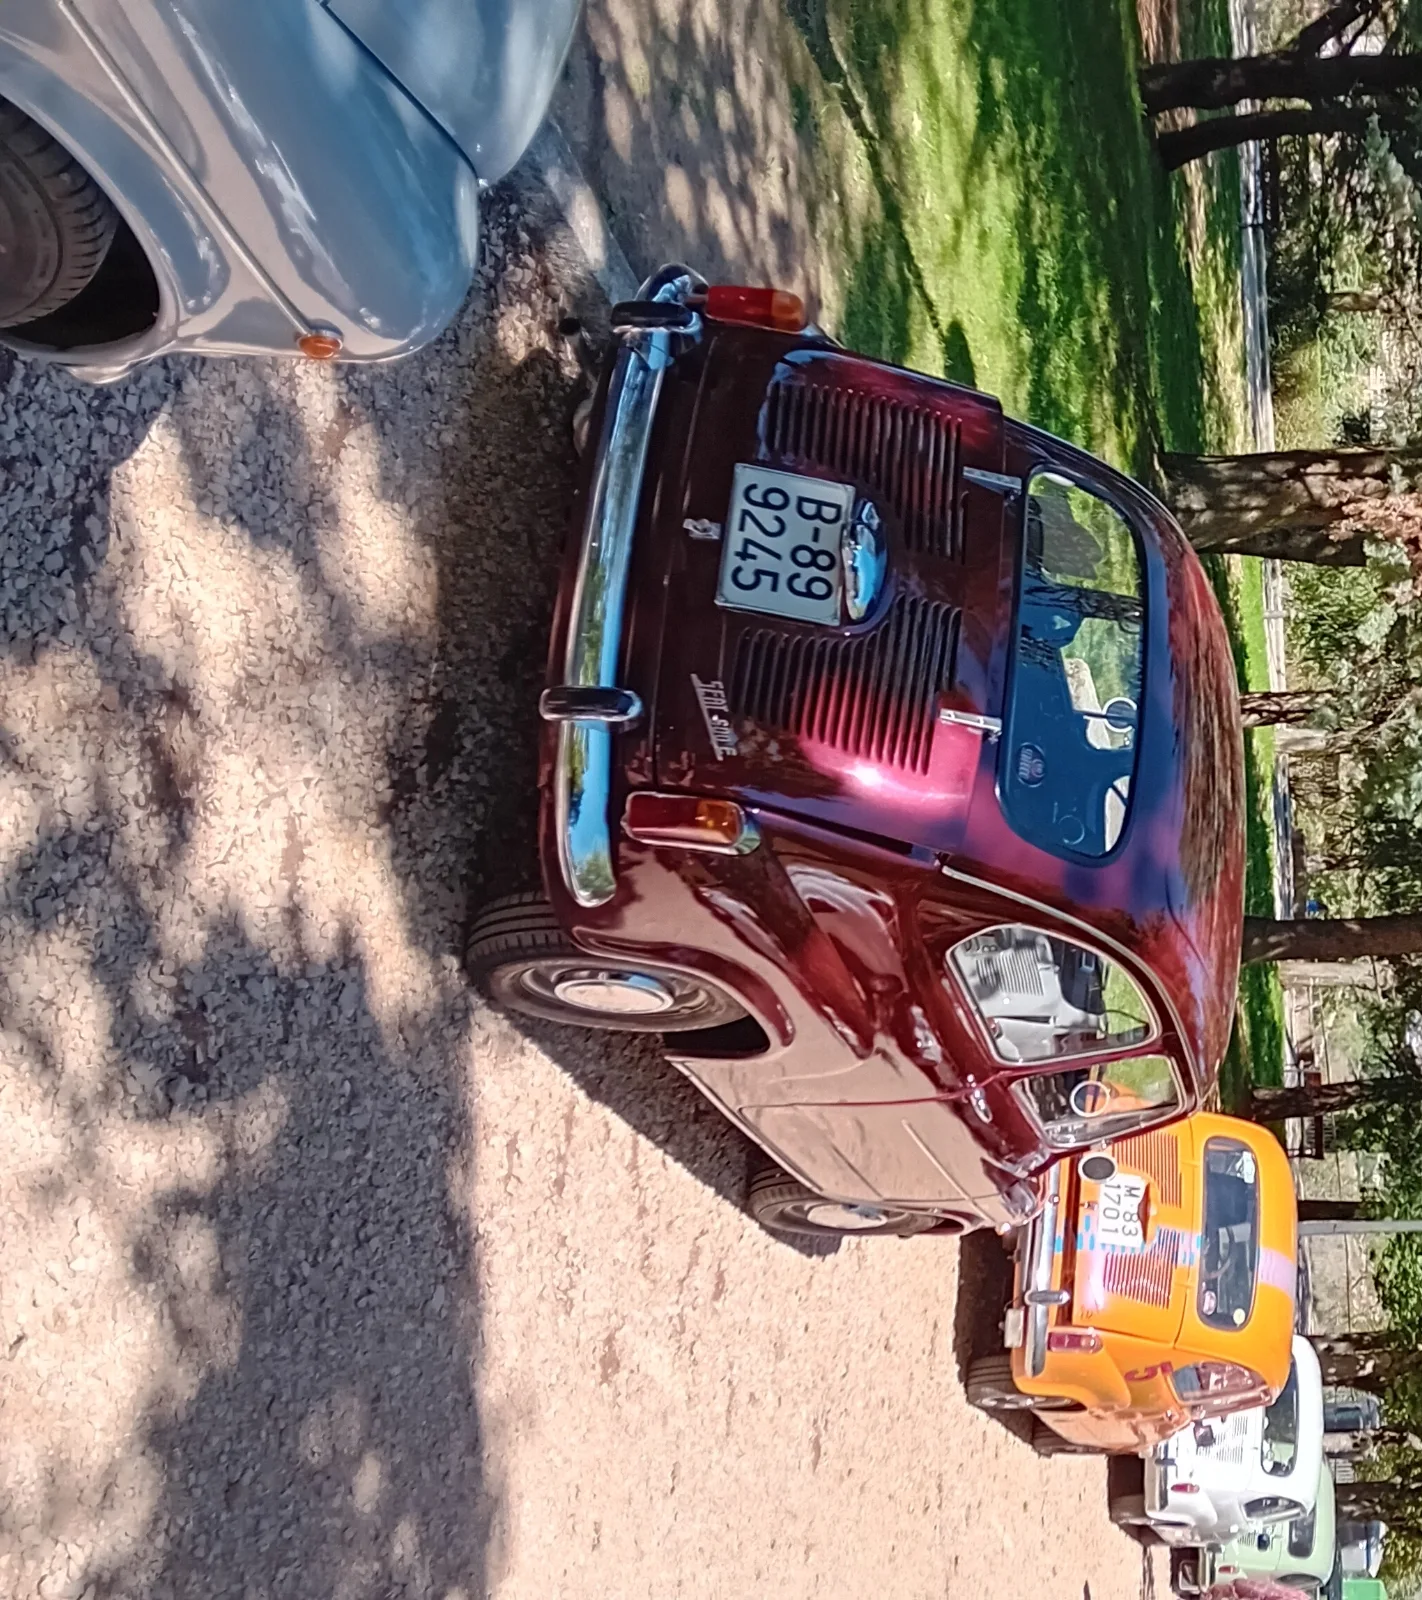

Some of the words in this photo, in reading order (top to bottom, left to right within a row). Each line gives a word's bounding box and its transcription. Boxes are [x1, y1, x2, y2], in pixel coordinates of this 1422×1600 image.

[731, 482, 790, 594] 9245
[786, 495, 842, 601] B-89
[697, 680, 730, 712] SEAT
[1101, 1184, 1121, 1234] 1701
